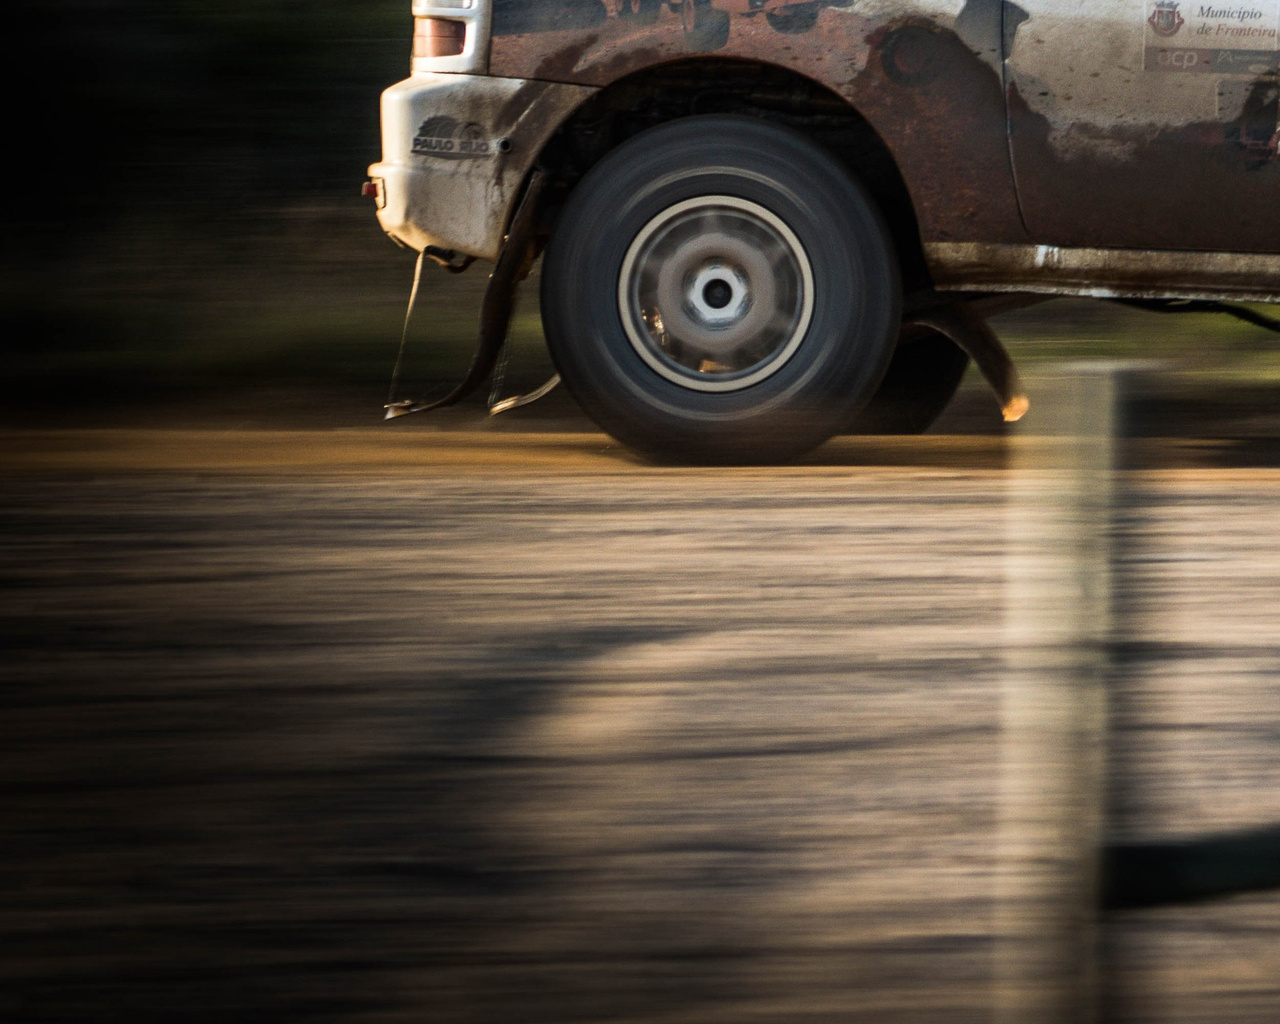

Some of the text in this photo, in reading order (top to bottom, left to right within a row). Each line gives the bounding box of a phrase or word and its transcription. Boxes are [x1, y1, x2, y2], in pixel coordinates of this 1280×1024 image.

[1197, 5, 1263, 22] Município
[1196, 22, 1277, 37] de Fronteira
[413, 137, 454, 152] PAULO
